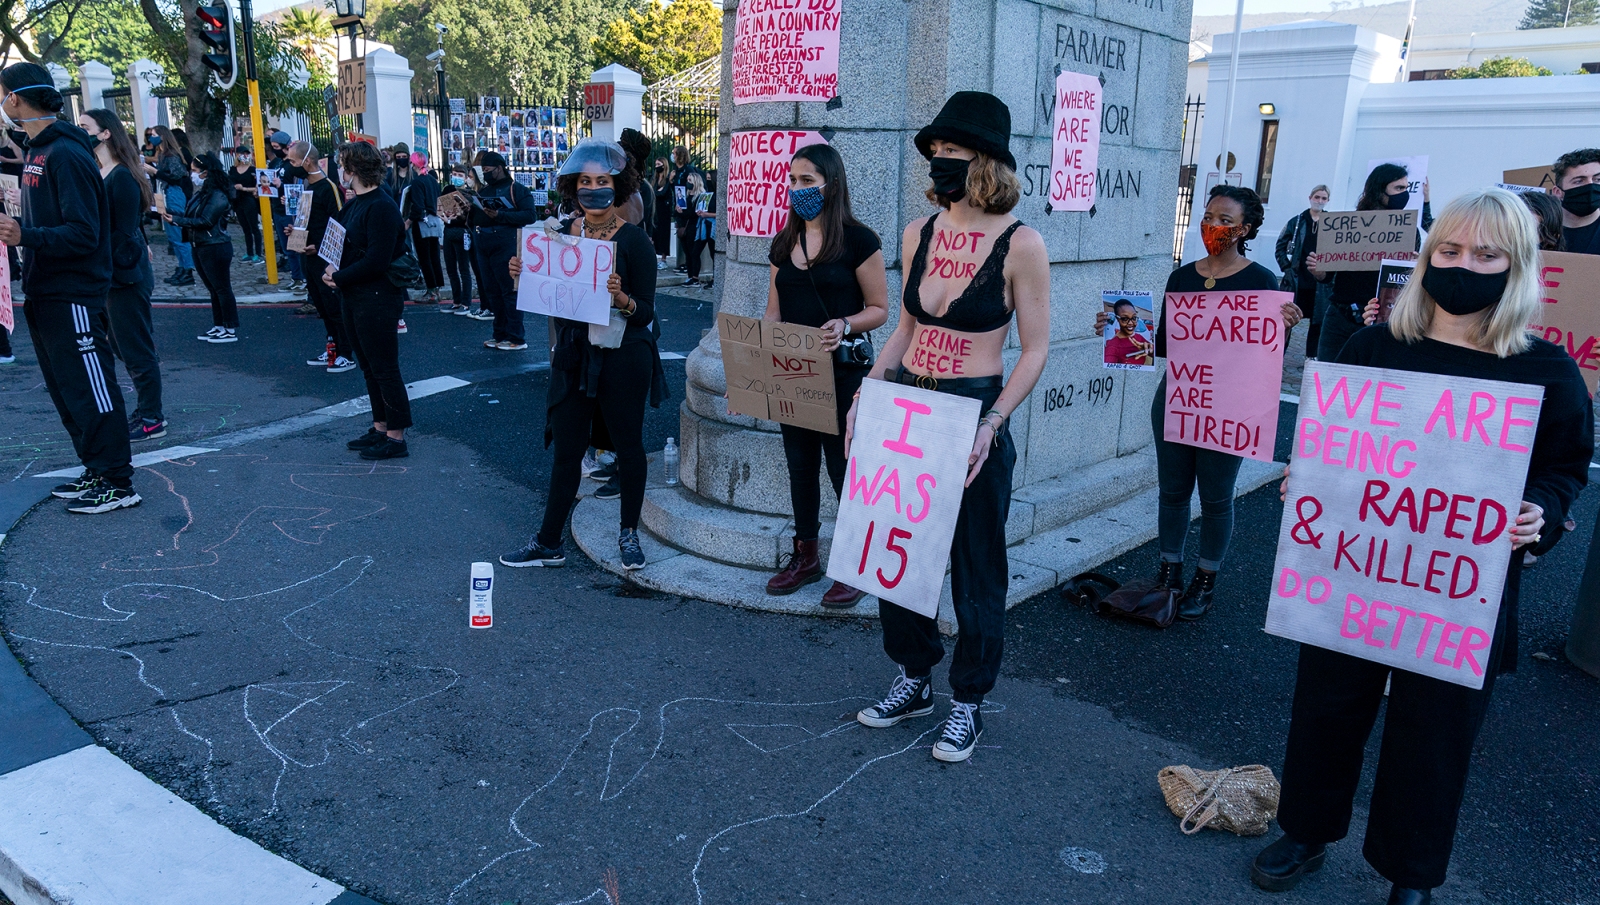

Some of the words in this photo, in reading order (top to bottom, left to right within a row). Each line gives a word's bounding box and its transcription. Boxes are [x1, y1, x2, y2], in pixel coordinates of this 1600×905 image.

[753, 15, 763, 34] IN
[767, 13, 775, 31] A
[778, 11, 840, 31] COUNTRY
[759, 32, 804, 50] PEOPLE
[1055, 24, 1126, 71] FARMER
[732, 49, 771, 71] PROTESTING
[771, 46, 825, 62] AGAINST
[753, 61, 803, 76] ARRESTED
[339, 64, 353, 85] AM
[358, 62, 364, 85] I
[752, 75, 769, 85] THAN
[772, 74, 788, 85] THE
[791, 74, 811, 85] PPL
[338, 85, 367, 111] NEXT?
[584, 84, 614, 105] STOP
[756, 84, 783, 97] COMMIT
[784, 84, 799, 94] THE
[801, 82, 838, 98] CRIMES
[1060, 89, 1096, 110] WHERE
[586, 104, 613, 120] GBV!
[1057, 117, 1090, 143] ARE
[731, 131, 807, 157] PROTECT
[729, 160, 757, 181] BLACK
[762, 160, 790, 183] WOM
[1064, 148, 1083, 170] WE
[728, 182, 772, 206] PROTECT
[1052, 170, 1095, 202] SAFE?
[728, 205, 753, 232] TRANS
[757, 208, 787, 235] LIV
[1322, 214, 1377, 231] SCREW
[1388, 213, 1412, 226] THE
[936, 229, 985, 253] NOT
[1334, 231, 1404, 244] BRO-CODE
[526, 233, 613, 293] STOP
[928, 256, 977, 279] YOUR
[1387, 273, 1410, 283] MISS
[539, 280, 587, 316] GBV
[1169, 295, 1207, 310] WE
[1217, 295, 1259, 311] ARE
[726, 319, 756, 340] MY
[773, 328, 826, 352] BODY
[919, 328, 972, 356] CRIME
[1171, 312, 1278, 352] SCARED,
[772, 353, 817, 373] NOT
[1170, 361, 1214, 385] WE
[742, 375, 785, 395] YOUR
[795, 386, 834, 402] PROPERTY
[1044, 384, 1074, 413] 1862
[1088, 376, 1114, 406] 1919
[1169, 386, 1213, 409] ARE
[779, 401, 795, 418] !!!
[1314, 372, 1406, 427] WE
[1424, 389, 1540, 453] ARE
[882, 397, 932, 459] I
[1171, 411, 1261, 455] TIRED!
[1298, 418, 1417, 478] BEING
[849, 456, 936, 523] WAS
[1359, 480, 1508, 545] RAPED
[858, 520, 913, 590] 15
[1290, 496, 1324, 549] &
[1334, 530, 1487, 604] KILLED.
[1277, 568, 1332, 605] DO
[1340, 593, 1491, 677] BETTER
